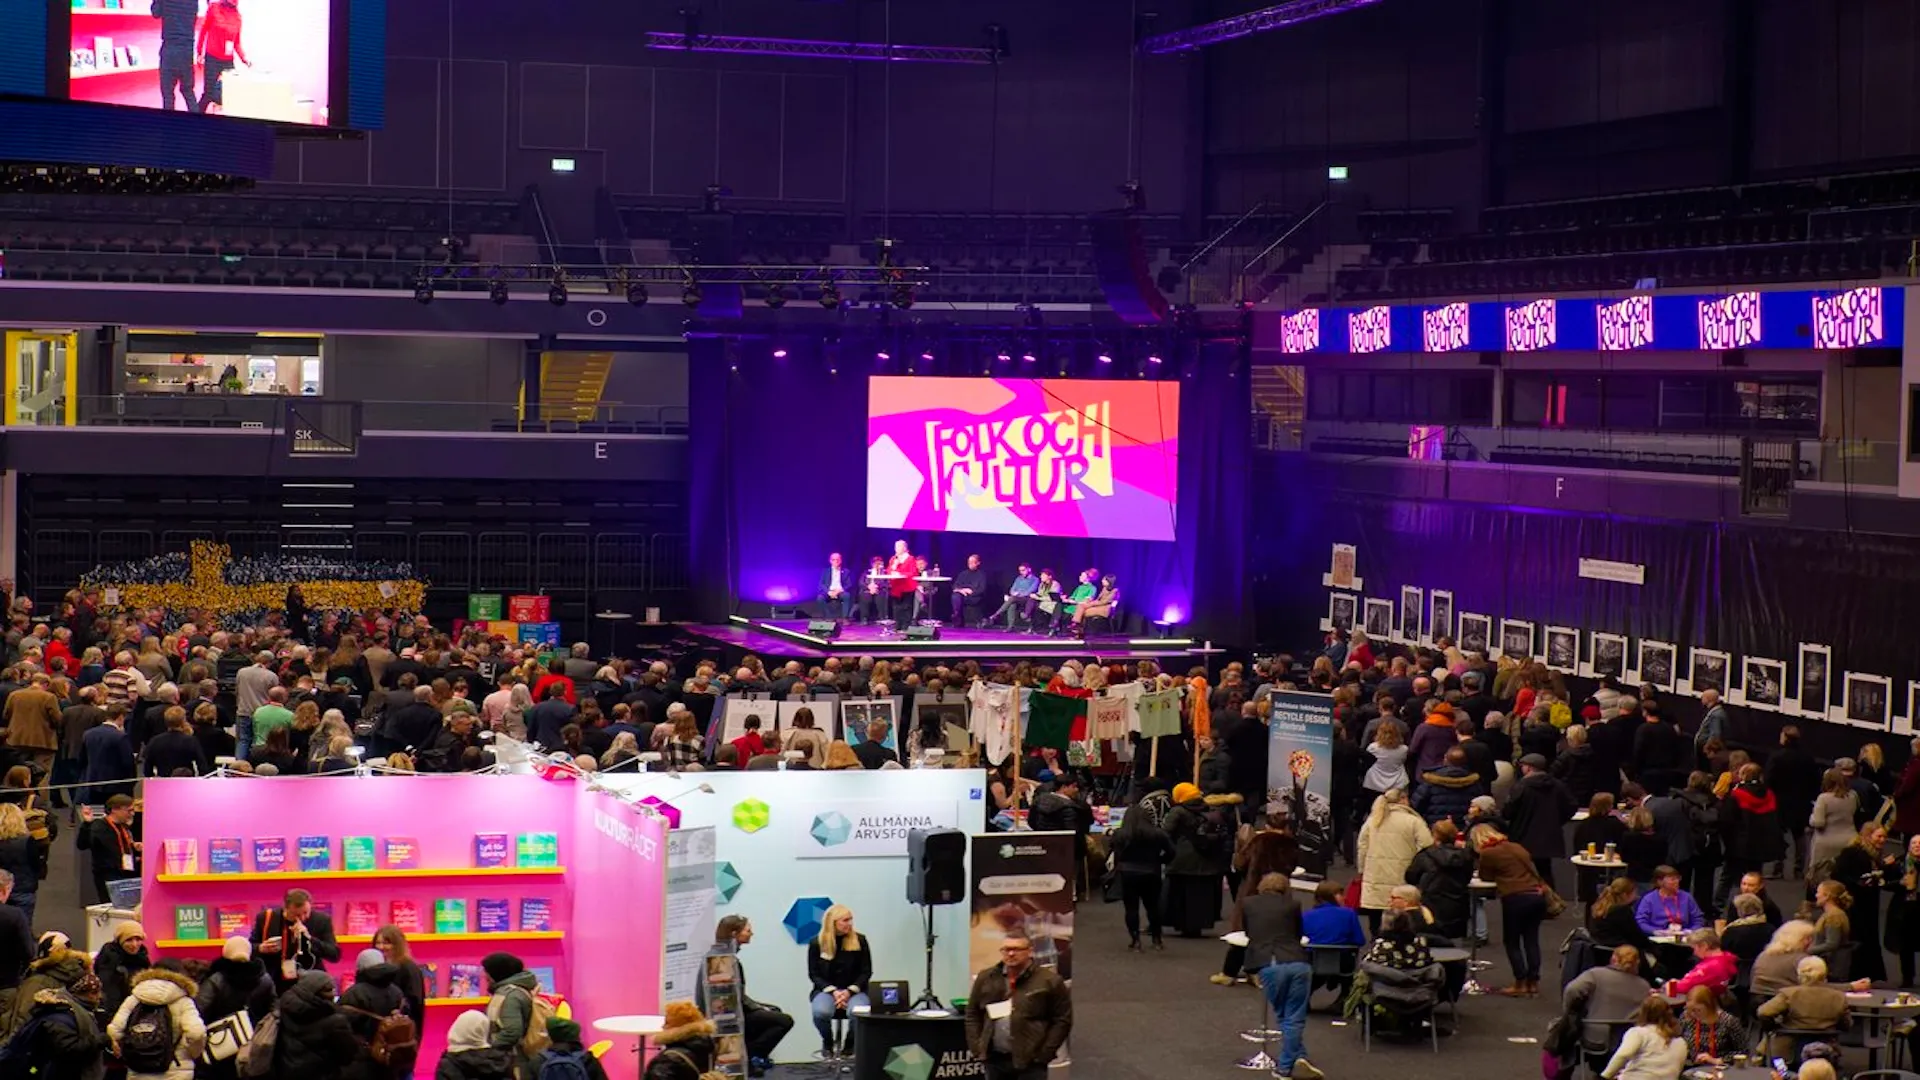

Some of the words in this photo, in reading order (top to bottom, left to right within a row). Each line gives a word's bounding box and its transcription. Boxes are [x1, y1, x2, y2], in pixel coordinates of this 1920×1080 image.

[1702, 298, 1729, 323] FOLK
[1731, 293, 1757, 318] OCH
[1816, 294, 1850, 320] FOLK
[1850, 287, 1878, 315] OCH
[1704, 319, 1756, 349] KULTUR
[1818, 314, 1877, 349] KULTUR
[295, 429, 313, 440] SK
[938, 421, 1026, 459] FOLK
[1023, 403, 1104, 458] OCH
[595, 442, 607, 458] E
[943, 451, 1103, 509] KULTUR
[1556, 477, 1564, 498] F
[1274, 711, 1304, 722] RECYCLE
[1305, 713, 1330, 725] DESIGN
[859, 813, 932, 827] ALLMÄNNA
[179, 908, 204, 921] MU
